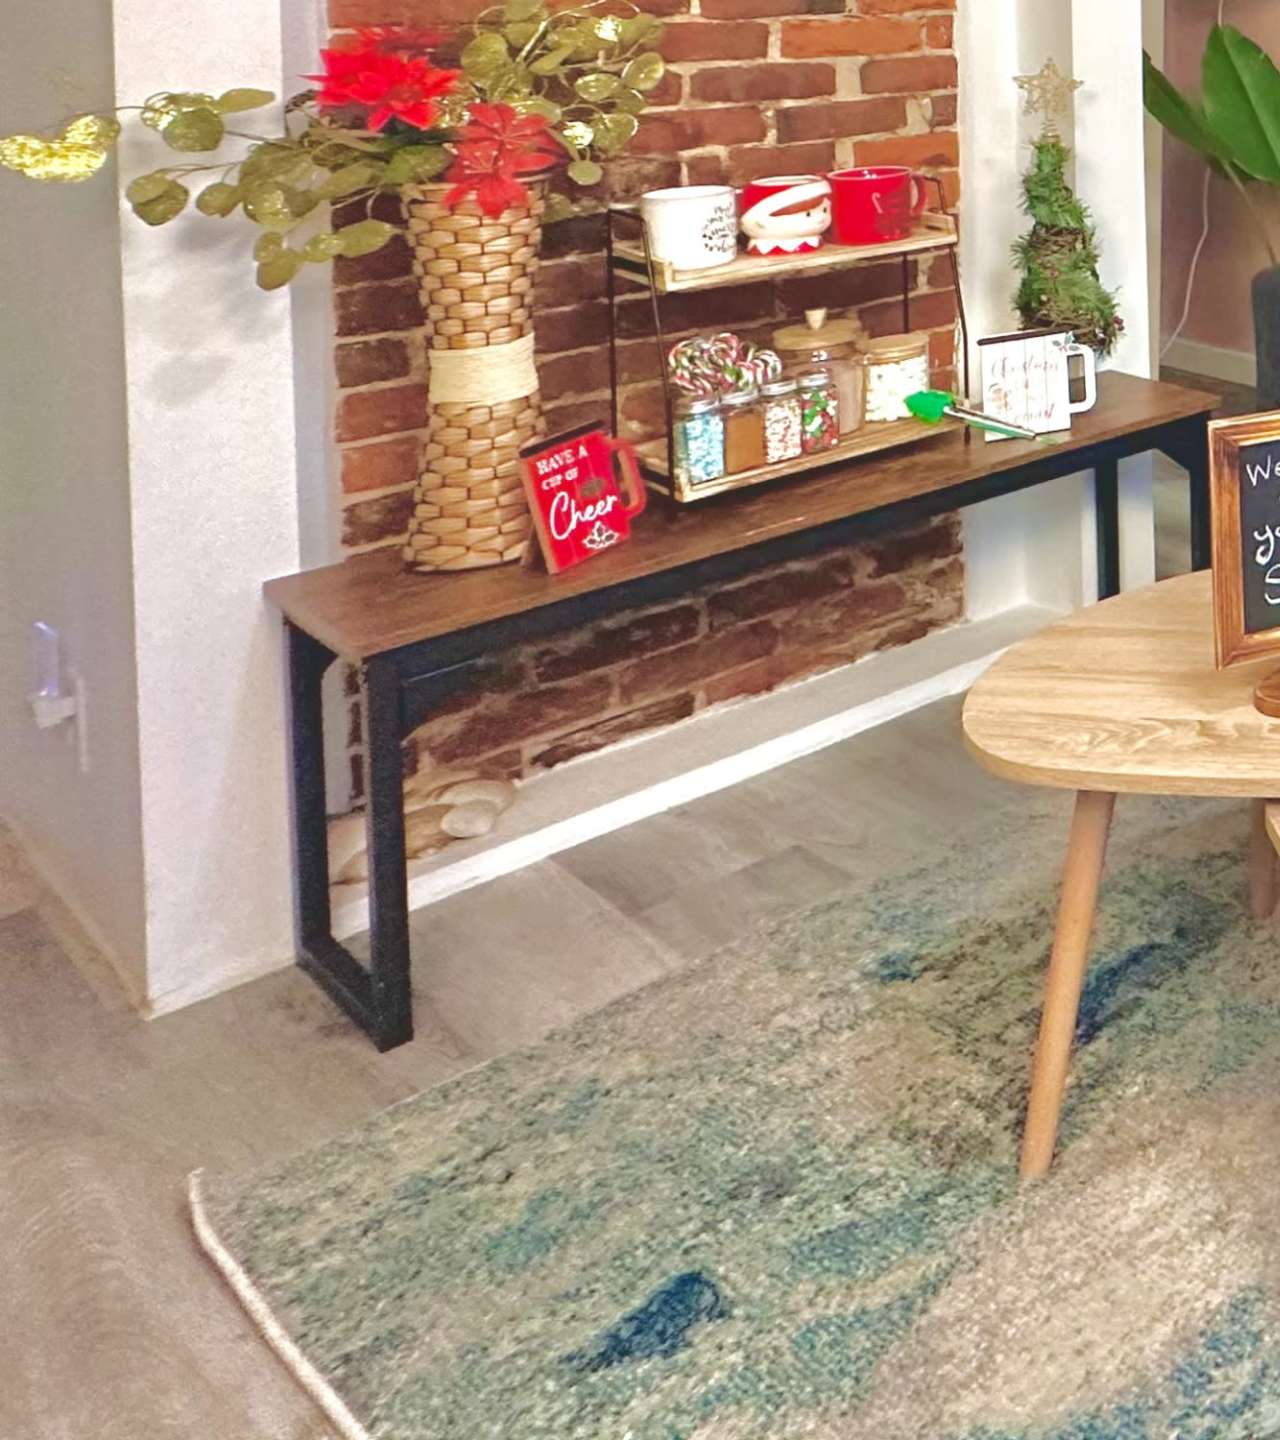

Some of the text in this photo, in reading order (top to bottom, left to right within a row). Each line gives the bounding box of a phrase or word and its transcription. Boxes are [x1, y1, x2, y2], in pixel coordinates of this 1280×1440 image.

[536, 445, 589, 475] HAVE A
[550, 491, 618, 541] Cheer
